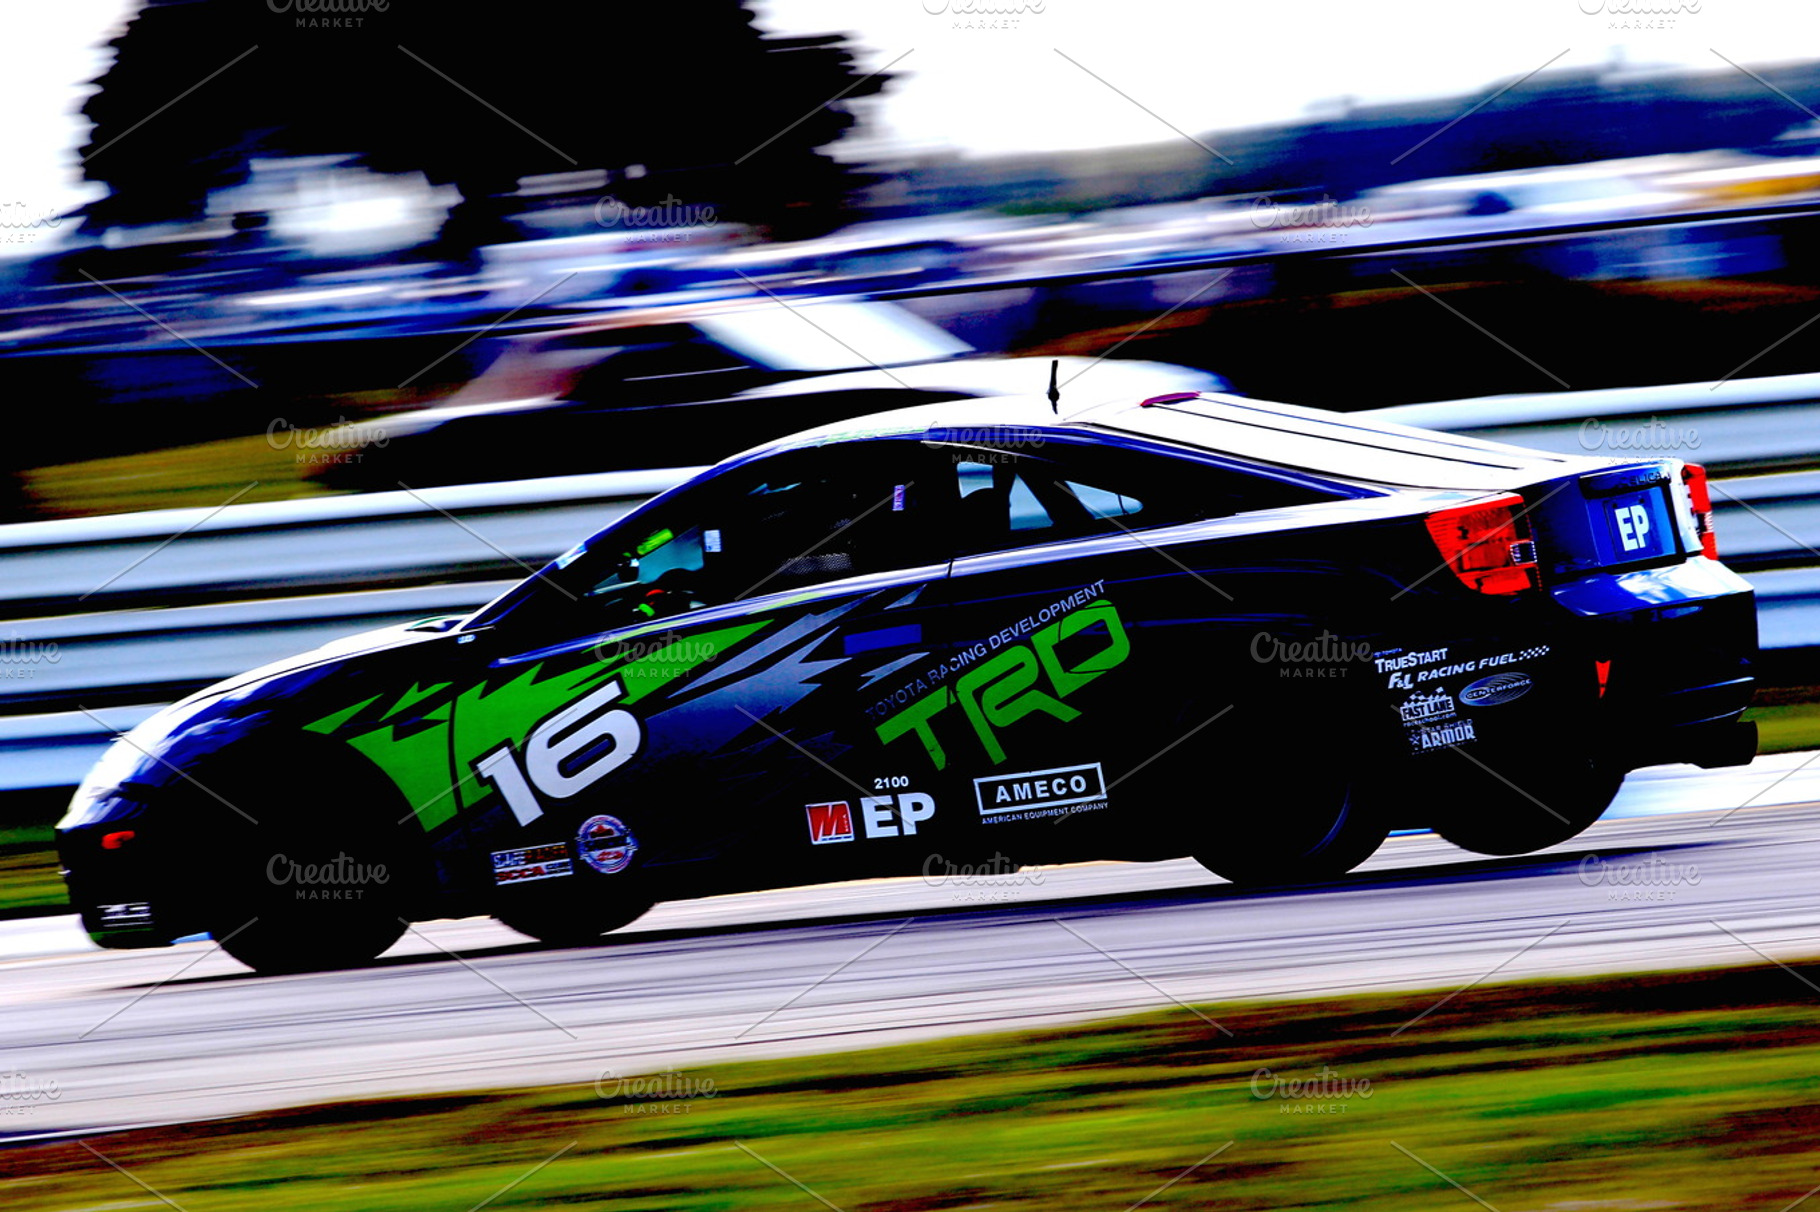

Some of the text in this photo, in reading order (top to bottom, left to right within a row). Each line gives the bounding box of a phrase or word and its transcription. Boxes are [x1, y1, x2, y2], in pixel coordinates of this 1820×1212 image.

[1615, 504, 1649, 552] EP
[866, 579, 1106, 720] TOYOTA RACING DEVELOPMENT
[875, 599, 1131, 771] TRD
[1388, 652, 1518, 690] F&L RACING FUEL
[1466, 678, 1532, 700] CENTERFORGE
[1402, 700, 1453, 720] FAST LANE
[476, 679, 641, 827] 16
[1421, 725, 1477, 749] ARMOR
[874, 776, 909, 789] 2100
[996, 775, 1087, 803] AMECO
[860, 792, 936, 839] EP
[982, 802, 1110, 824] AMERICAN EQUIPMENT COMPANY
